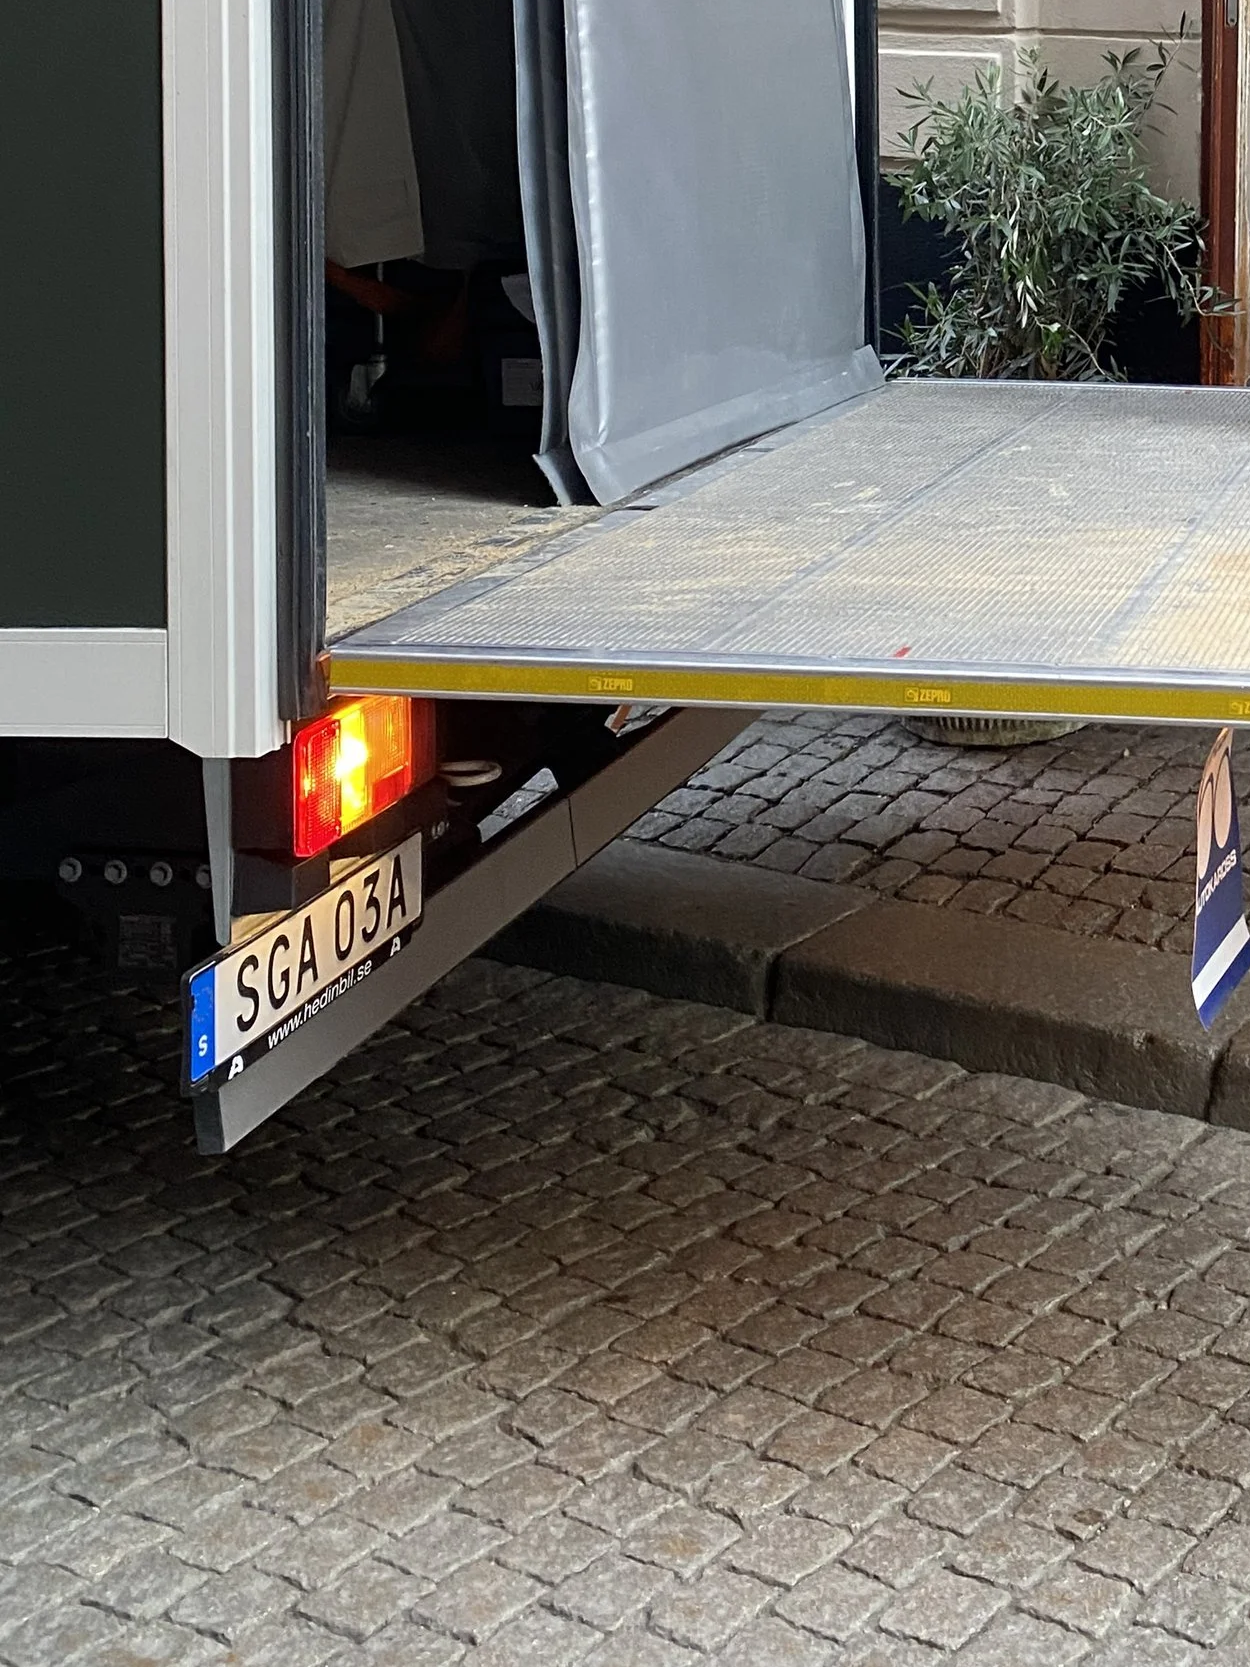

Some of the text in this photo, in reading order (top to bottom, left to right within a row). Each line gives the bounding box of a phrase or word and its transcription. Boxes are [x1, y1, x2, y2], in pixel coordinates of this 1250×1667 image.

[602, 677, 633, 691] ZEPRO
[920, 688, 951, 703] ZEPRO
[236, 915, 319, 1032] SGA
[334, 855, 407, 961] 03A
[267, 959, 373, 1050] www.hedinbil.se
[197, 1034, 208, 1057] S
